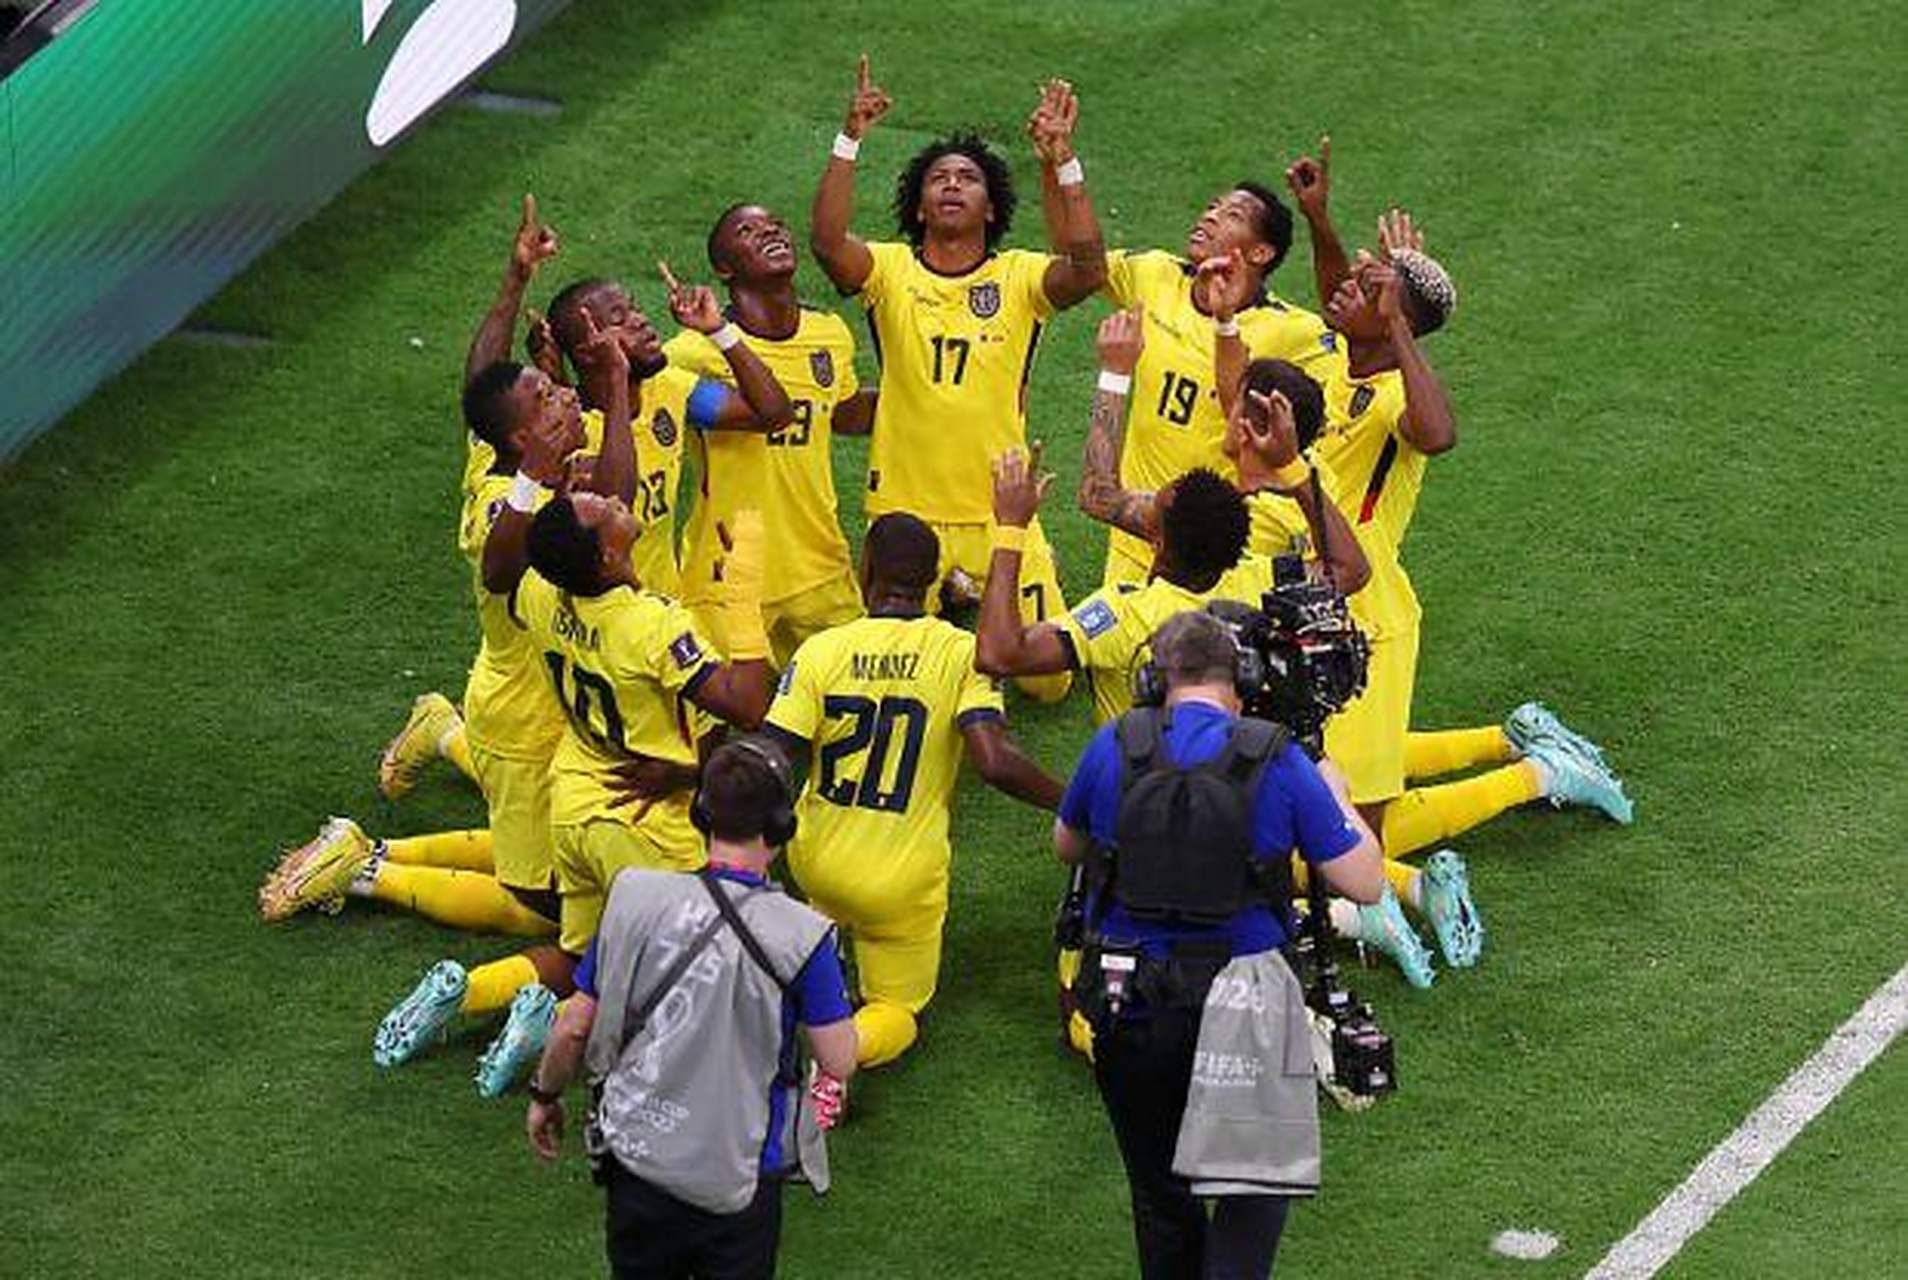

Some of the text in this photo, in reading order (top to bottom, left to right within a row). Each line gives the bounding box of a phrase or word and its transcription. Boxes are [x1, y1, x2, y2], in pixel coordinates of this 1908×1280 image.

[930, 335, 970, 385] 17
[1157, 371, 1199, 425] 19
[544, 649, 626, 758] 10
[817, 694, 929, 813] 20
